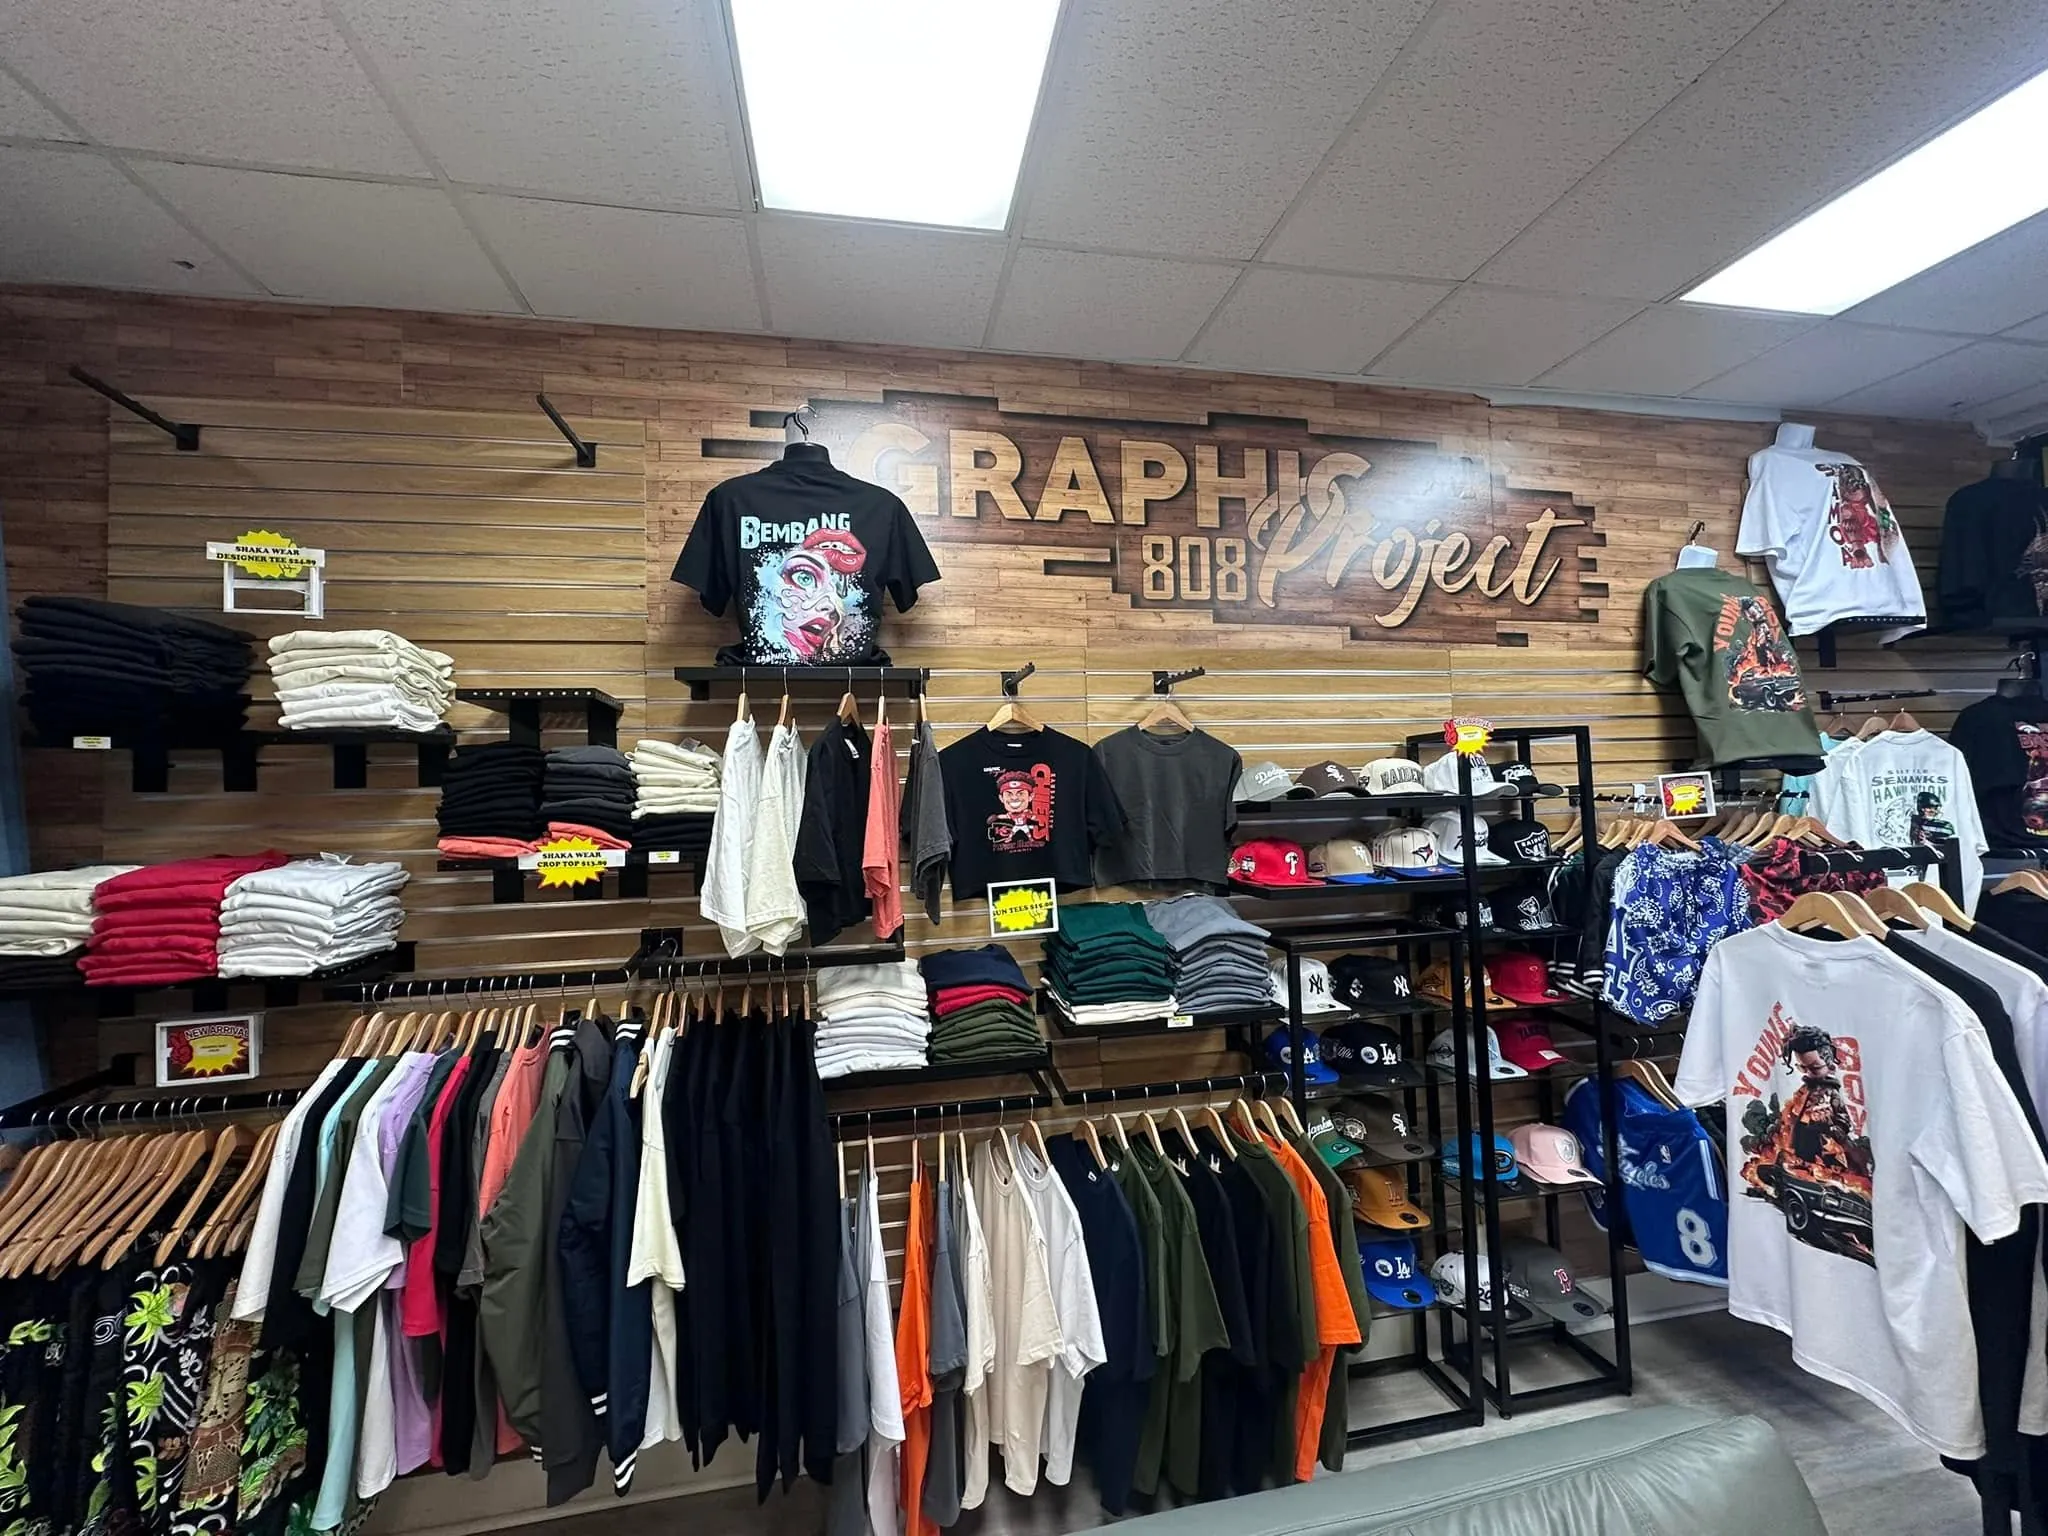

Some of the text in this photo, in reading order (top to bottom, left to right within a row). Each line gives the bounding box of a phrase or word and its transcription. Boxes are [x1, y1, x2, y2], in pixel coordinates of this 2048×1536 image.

[740, 512, 851, 550] BEMBANG
[216, 552, 267, 563] DESIGNER
[268, 556, 287, 564] TEE
[235, 545, 300, 556] SHAKA WEAR
[1140, 478, 1587, 628] 808 Project
[537, 860, 561, 868] CROP
[562, 859, 580, 867] TOP
[542, 852, 573, 860] SHAKA
[1308, 973, 1324, 995] NY
[1393, 974, 1411, 998] NY
[184, 1026, 208, 1040] NEW
[1379, 1043, 1398, 1066] LA
[1676, 1206, 1719, 1269] 8
[1394, 1256, 1411, 1279] LA
